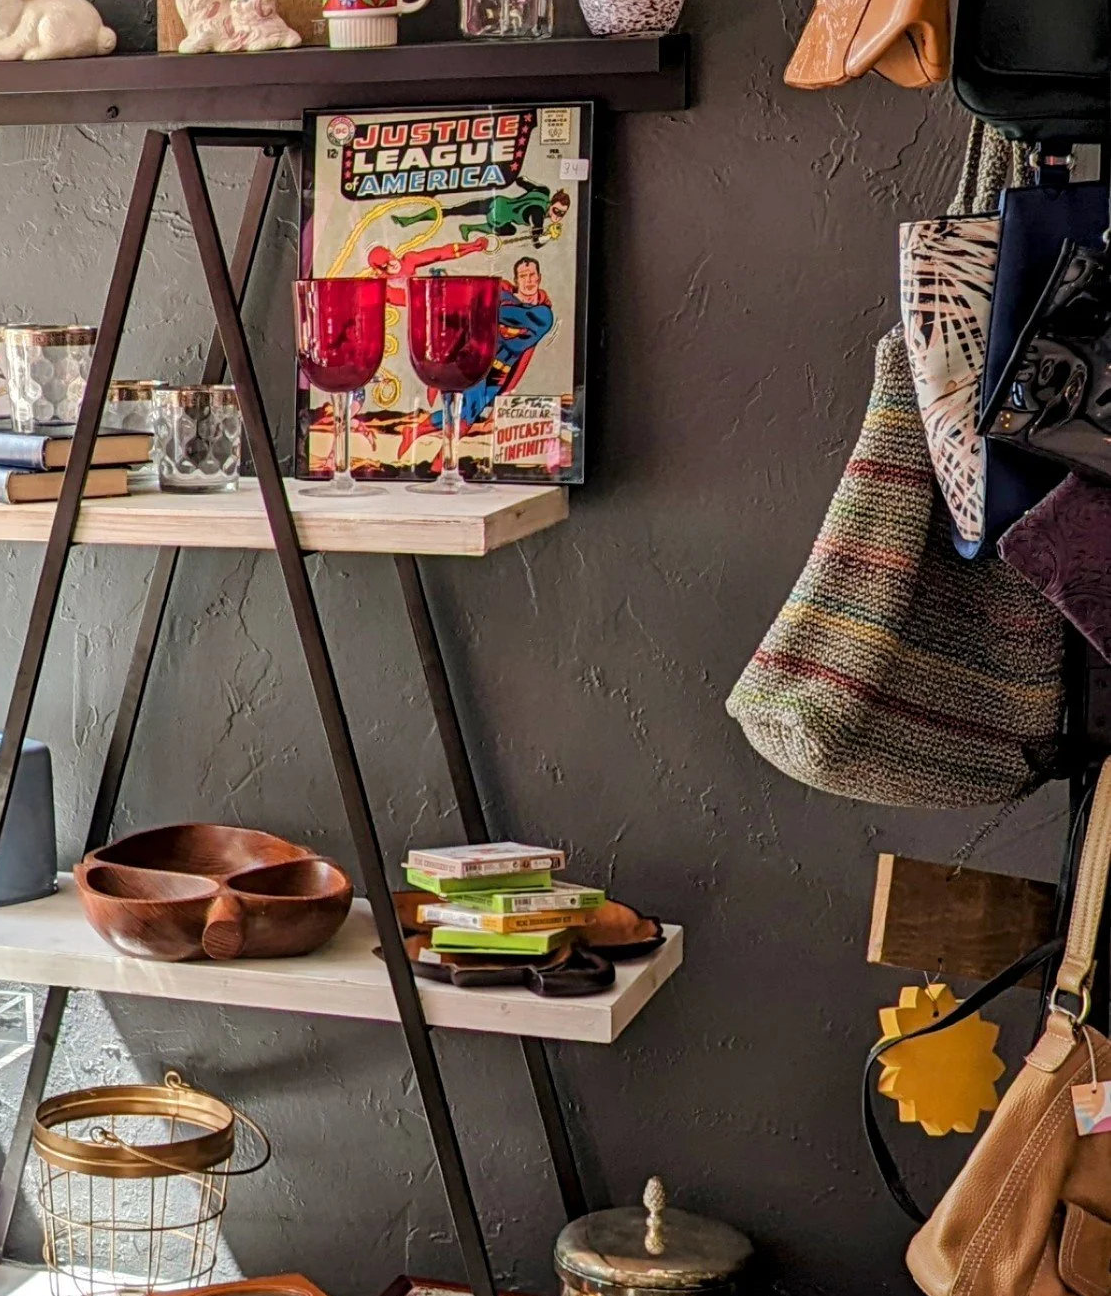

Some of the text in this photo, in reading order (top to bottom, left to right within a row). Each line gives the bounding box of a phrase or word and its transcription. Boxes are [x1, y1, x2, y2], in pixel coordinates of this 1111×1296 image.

[353, 115, 520, 149] JUSTICE
[353, 139, 516, 174] LEAGUE
[344, 164, 506, 197] of AMERICA
[495, 447, 503, 463] of
